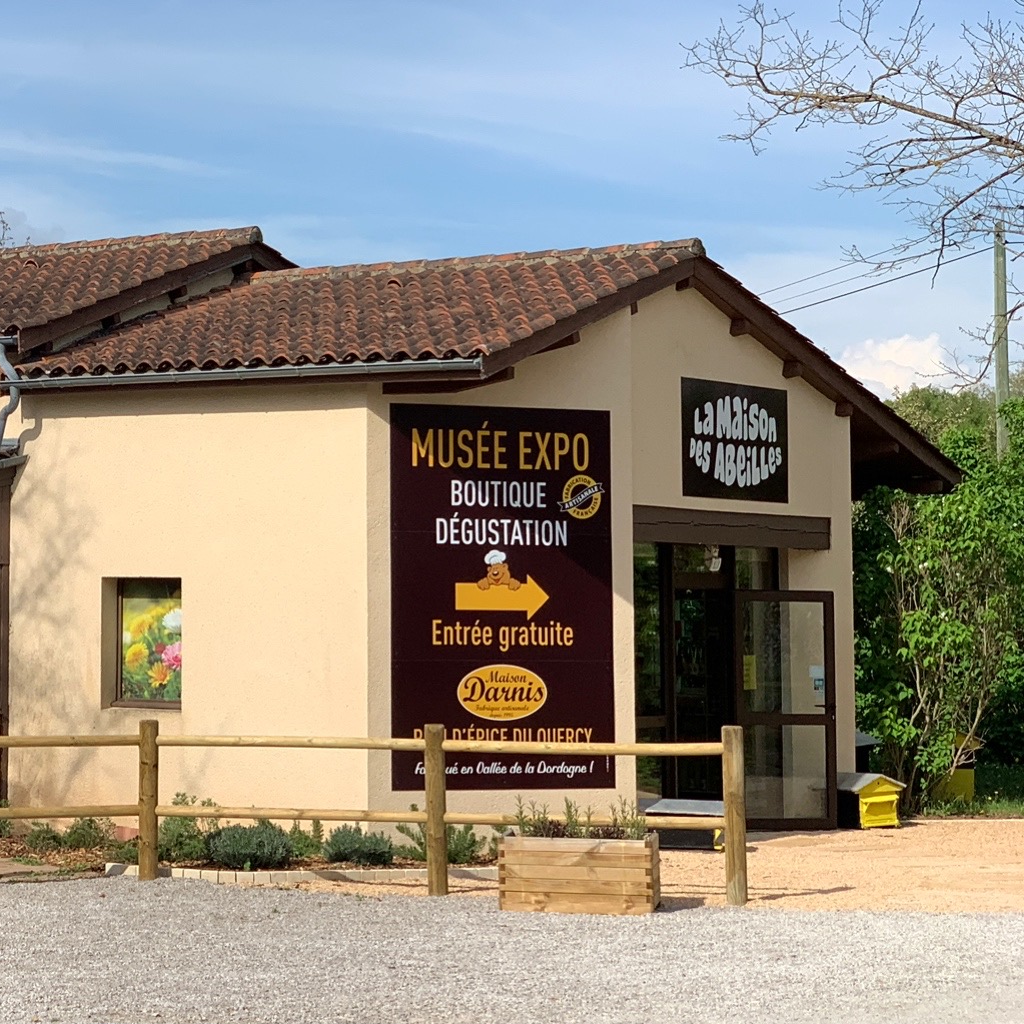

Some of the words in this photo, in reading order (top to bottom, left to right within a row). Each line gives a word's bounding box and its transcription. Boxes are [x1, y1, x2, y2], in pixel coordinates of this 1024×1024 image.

[694, 401, 715, 436] La
[716, 395, 777, 443] Maison
[411, 421, 508, 469] MUSÉE
[519, 431, 590, 472] EXPO
[450, 479, 547, 508] BOUTIQUE
[564, 485, 599, 509] ARTISANALE
[435, 511, 568, 546] DÉGUSTATION
[432, 619, 493, 646] Entrée
[499, 620, 574, 652] gratuite
[462, 675, 545, 702] Darnis
[485, 670, 527, 683] Maison
[414, 761, 459, 775] Faué
[461, 766, 474, 775] en
[476, 760, 507, 775] Vallée
[509, 761, 522, 775] de
[525, 761, 535, 775] la
[537, 760, 587, 779] Dordogne
